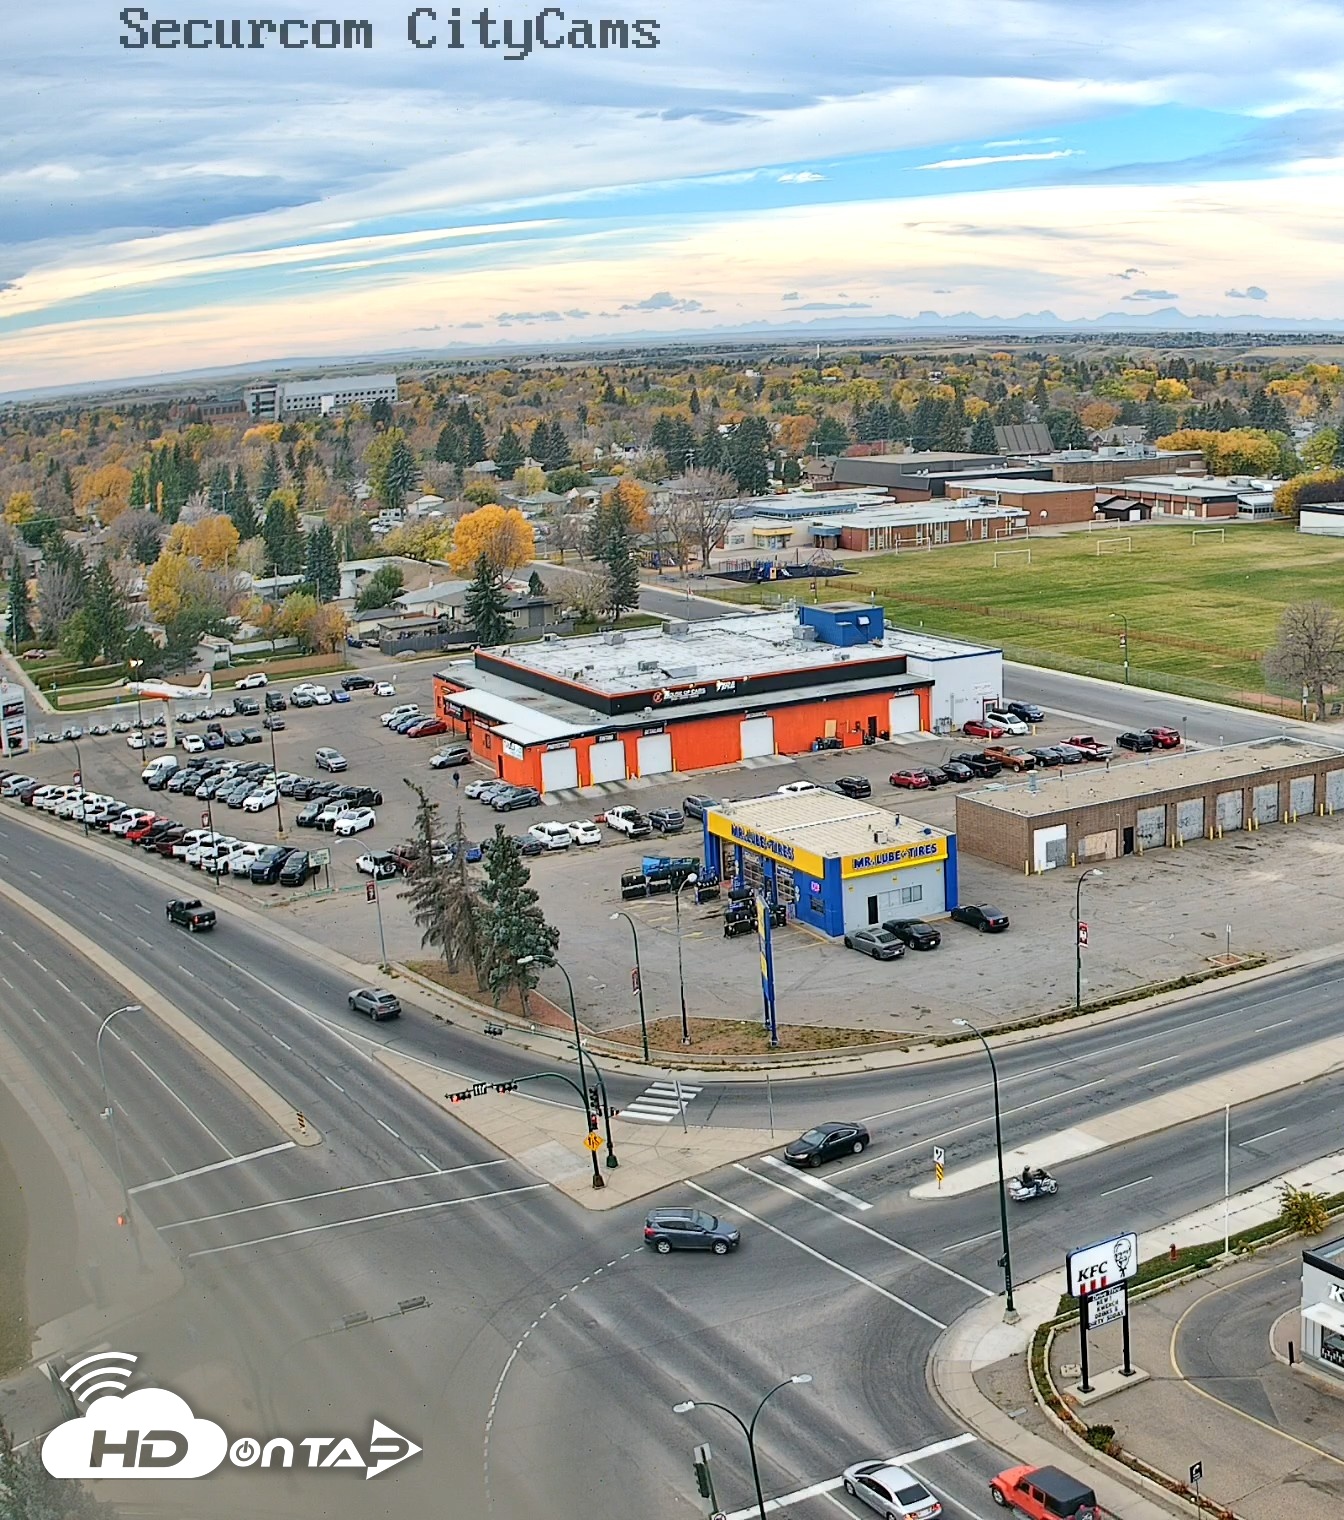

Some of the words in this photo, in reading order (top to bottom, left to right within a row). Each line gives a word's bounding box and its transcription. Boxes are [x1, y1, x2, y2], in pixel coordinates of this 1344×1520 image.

[876, 850, 901, 865] LUBE
[909, 843, 937, 857] TIRES
[1077, 1260, 1108, 1282] KFC
